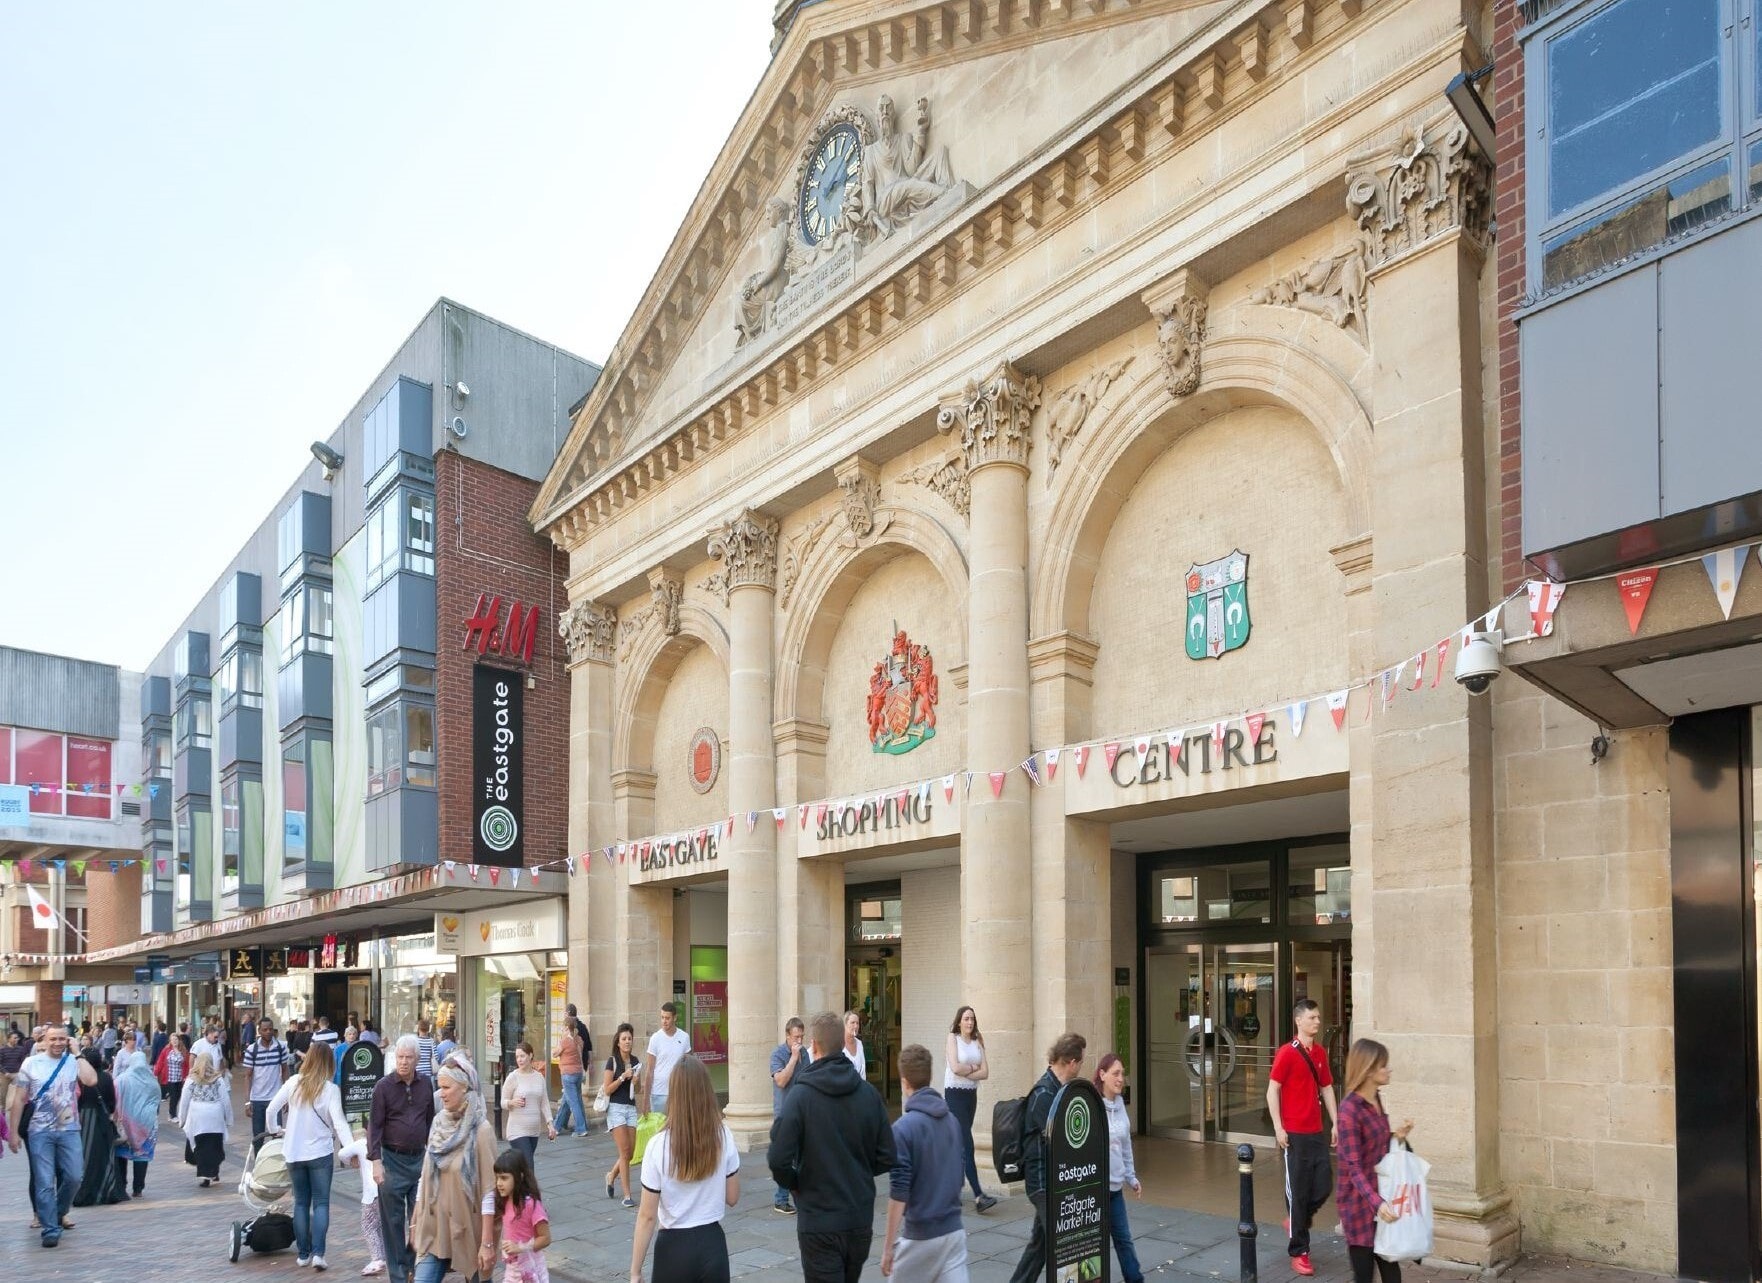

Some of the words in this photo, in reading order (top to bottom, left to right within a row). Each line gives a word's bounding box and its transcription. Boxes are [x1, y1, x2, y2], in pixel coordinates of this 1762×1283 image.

[463, 593, 540, 664] H&M
[493, 682, 514, 802] eastgate
[1110, 720, 1278, 788] CENTRE
[486, 777, 494, 799] THE
[491, 924, 516, 941] Thomas
[516, 919, 535, 938] Cook
[1058, 1163, 1097, 1182] eastgate
[1060, 1195, 1096, 1217] Eastgate
[1056, 1213, 1084, 1233] Market
[1085, 1207, 1101, 1225] Hall
